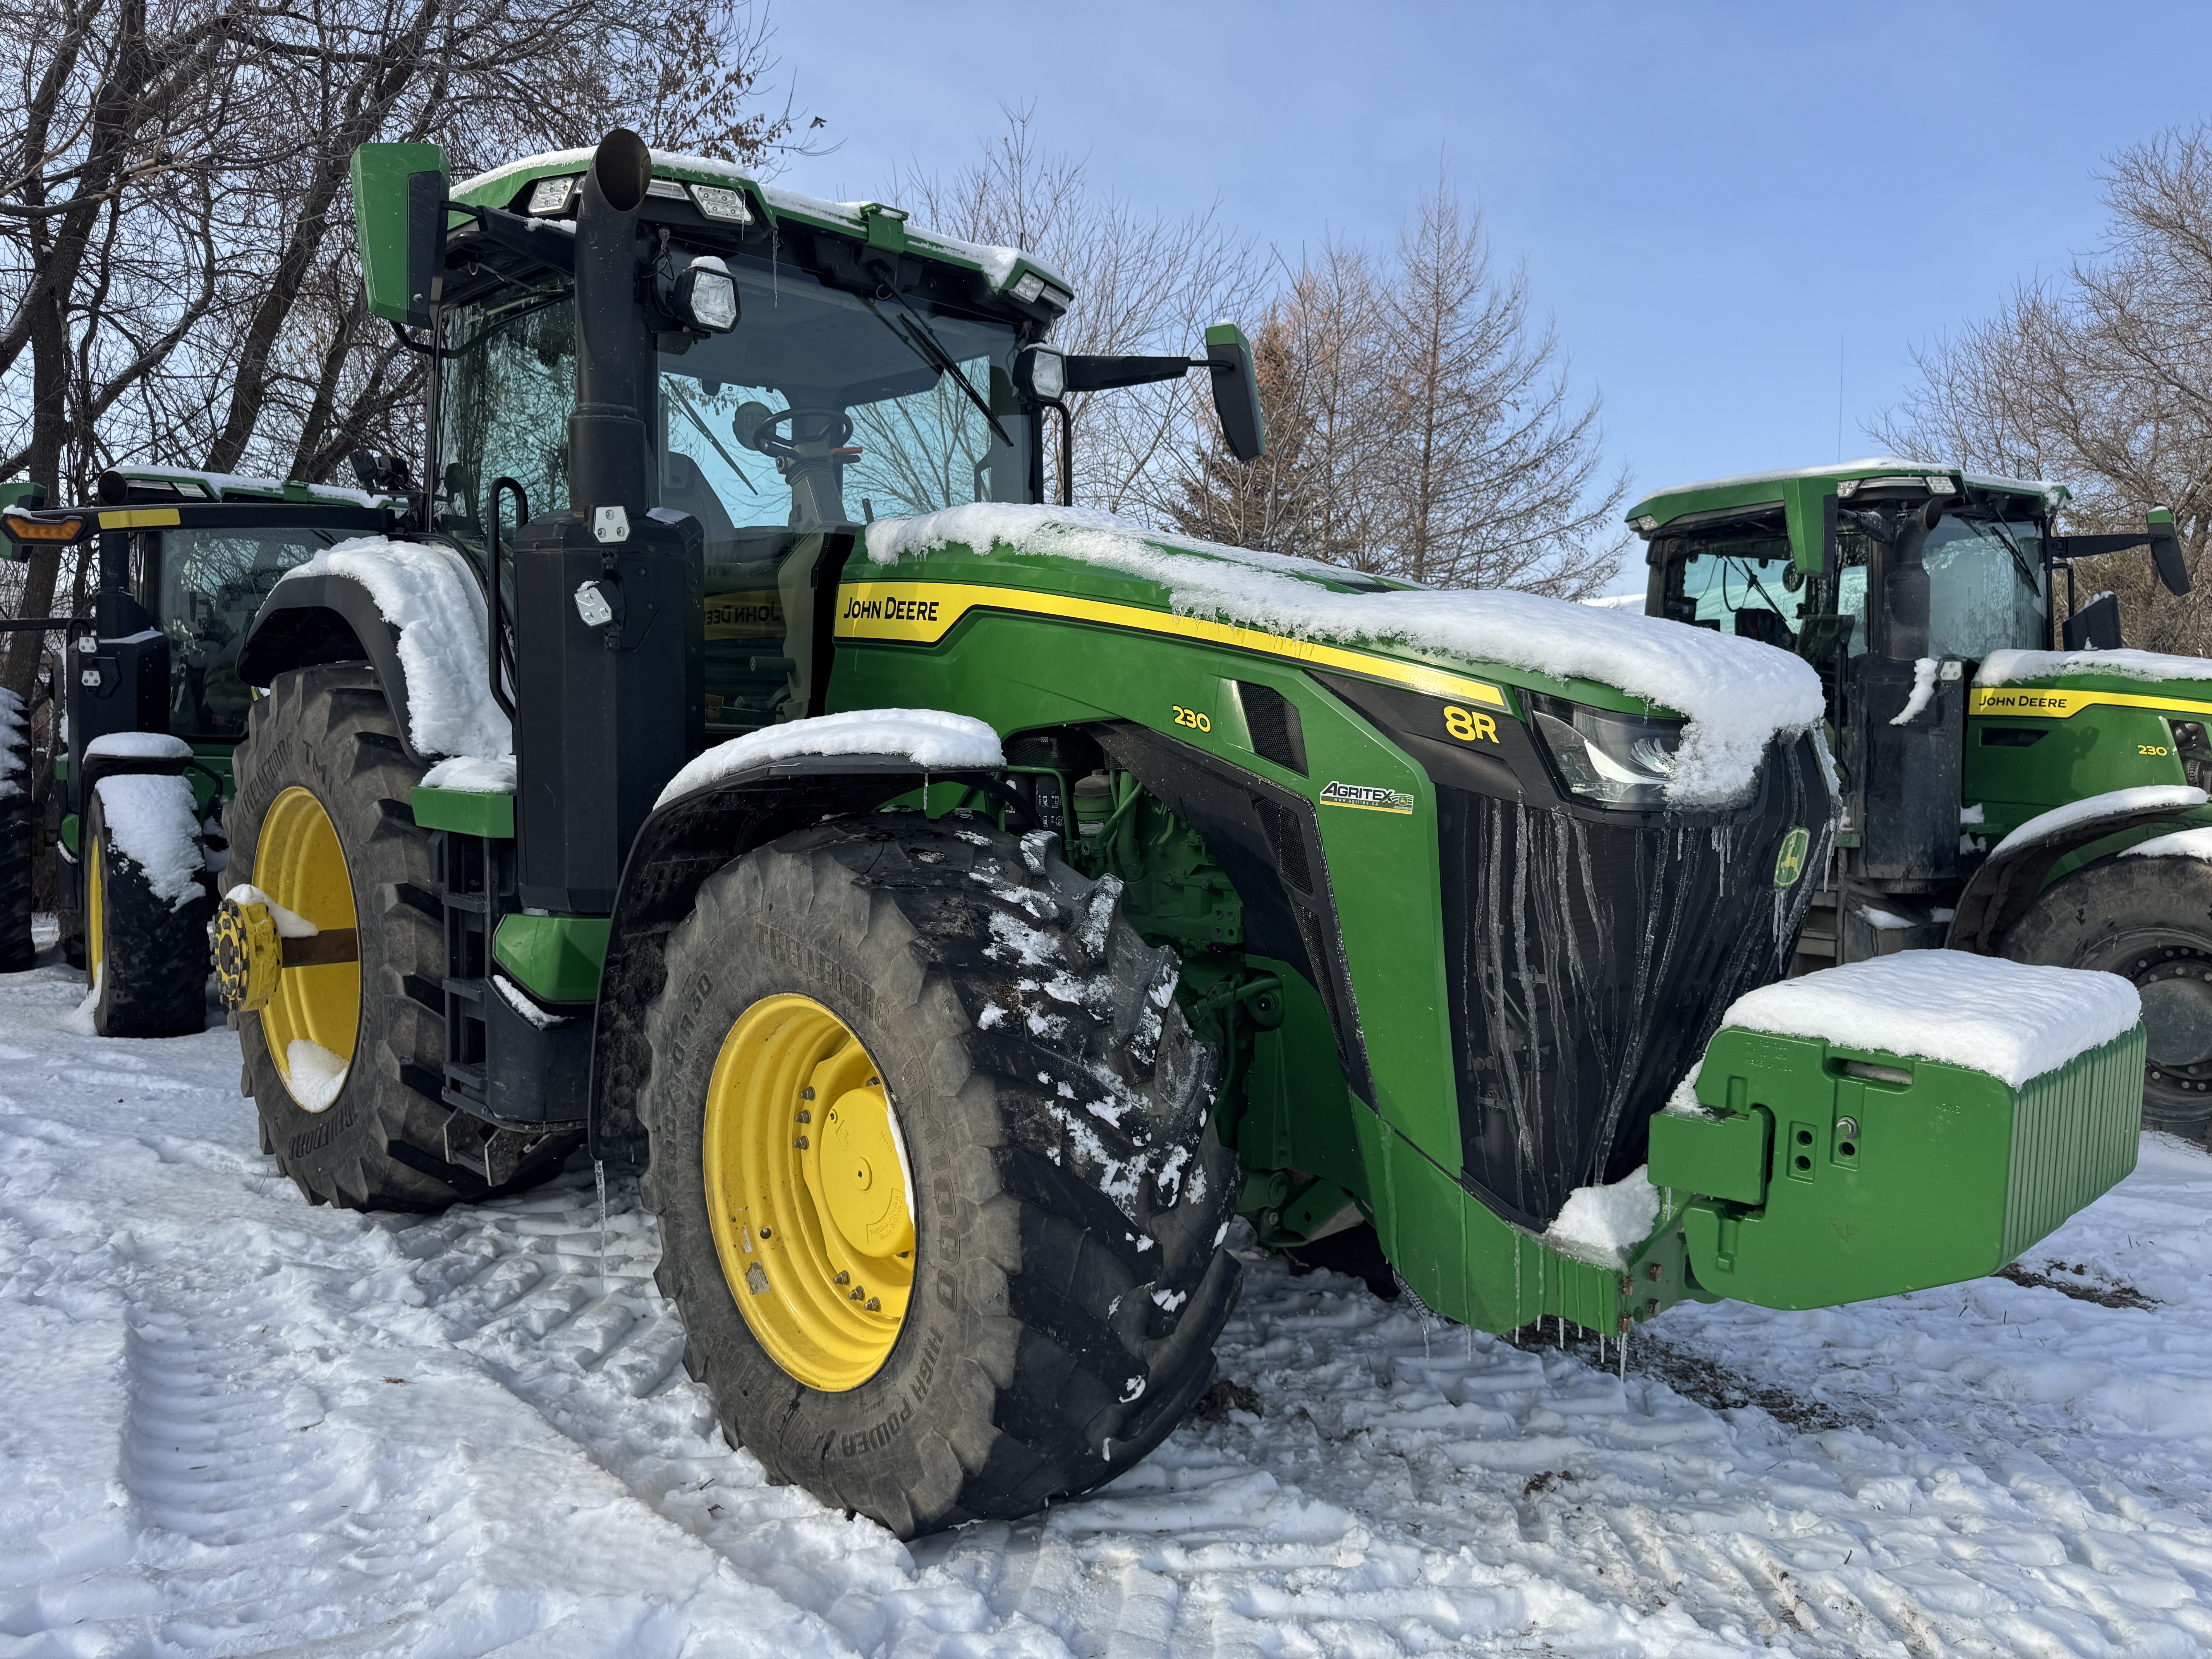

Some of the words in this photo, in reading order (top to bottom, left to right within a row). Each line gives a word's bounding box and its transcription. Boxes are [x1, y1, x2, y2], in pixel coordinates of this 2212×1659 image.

[843, 597, 882, 619] JOHN
[884, 597, 939, 621] DEERE
[1979, 696, 2015, 706] JOHN
[2018, 696, 2067, 708] DEERE
[1172, 705, 1211, 733] 230
[1444, 706, 1500, 744] 8R
[2137, 745, 2168, 756] 230
[239, 733, 293, 821] TRELLEBORG
[1322, 783, 1393, 802] AGRITEX
[1334, 797, 1379, 806] www.agritex.ca
[756, 921, 890, 1032] TRELLEBORG
[289, 1094, 358, 1160] TRELLEBORG
[911, 1322, 944, 1405] HIGH
[840, 1393, 914, 1458] POWER
